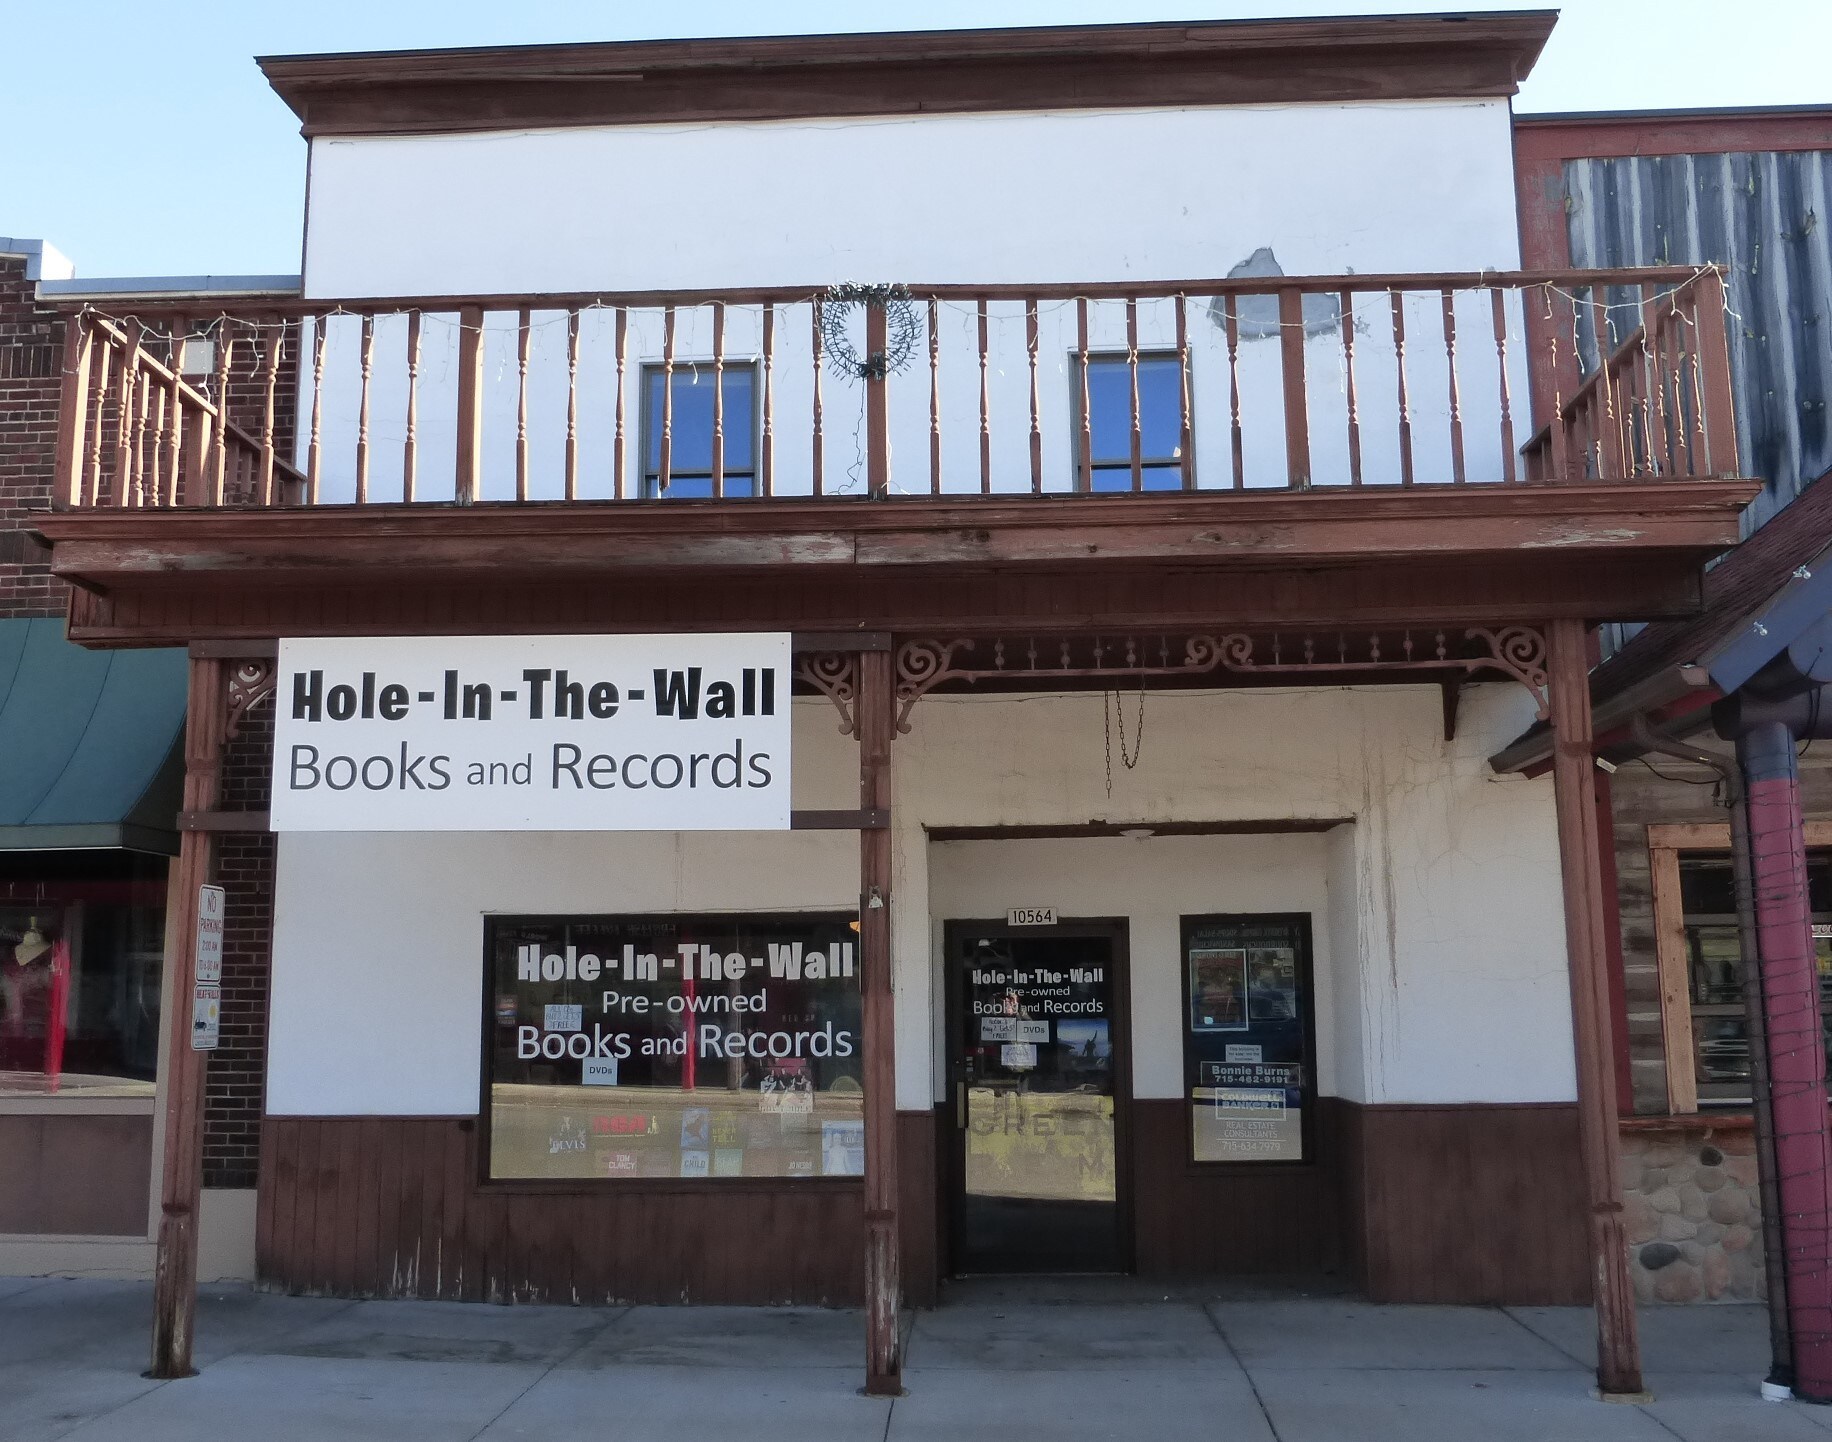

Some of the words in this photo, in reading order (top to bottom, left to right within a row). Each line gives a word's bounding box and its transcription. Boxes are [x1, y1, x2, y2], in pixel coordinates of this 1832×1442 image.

[292, 666, 776, 723] Hole-In-The-Wall
[289, 740, 452, 791] Books
[466, 752, 533, 785] and
[552, 738, 773, 790] Records
[207, 894, 217, 913] NO
[1013, 910, 1052, 924] 10564
[517, 942, 853, 982] Hole-In-The-Wall
[972, 967, 1103, 985] Hole-In-The-Wall
[1006, 985, 1070, 997] Pre-owned
[602, 988, 767, 1014] Pre-owned
[1044, 998, 1103, 1014] Records
[1023, 1026, 1045, 1034] DVDs
[517, 1023, 631, 1060] Books
[641, 1032, 688, 1056] and
[700, 1021, 853, 1058] Records
[589, 1065, 613, 1075] DVDs
[1212, 1065, 1253, 1075] Bonnie
[1255, 1066, 1290, 1076] Burns
[1226, 1121, 1245, 1130] REAL
[1248, 1121, 1276, 1130] ESTATE
[1223, 1129, 1278, 1139] CONSULTANTS
